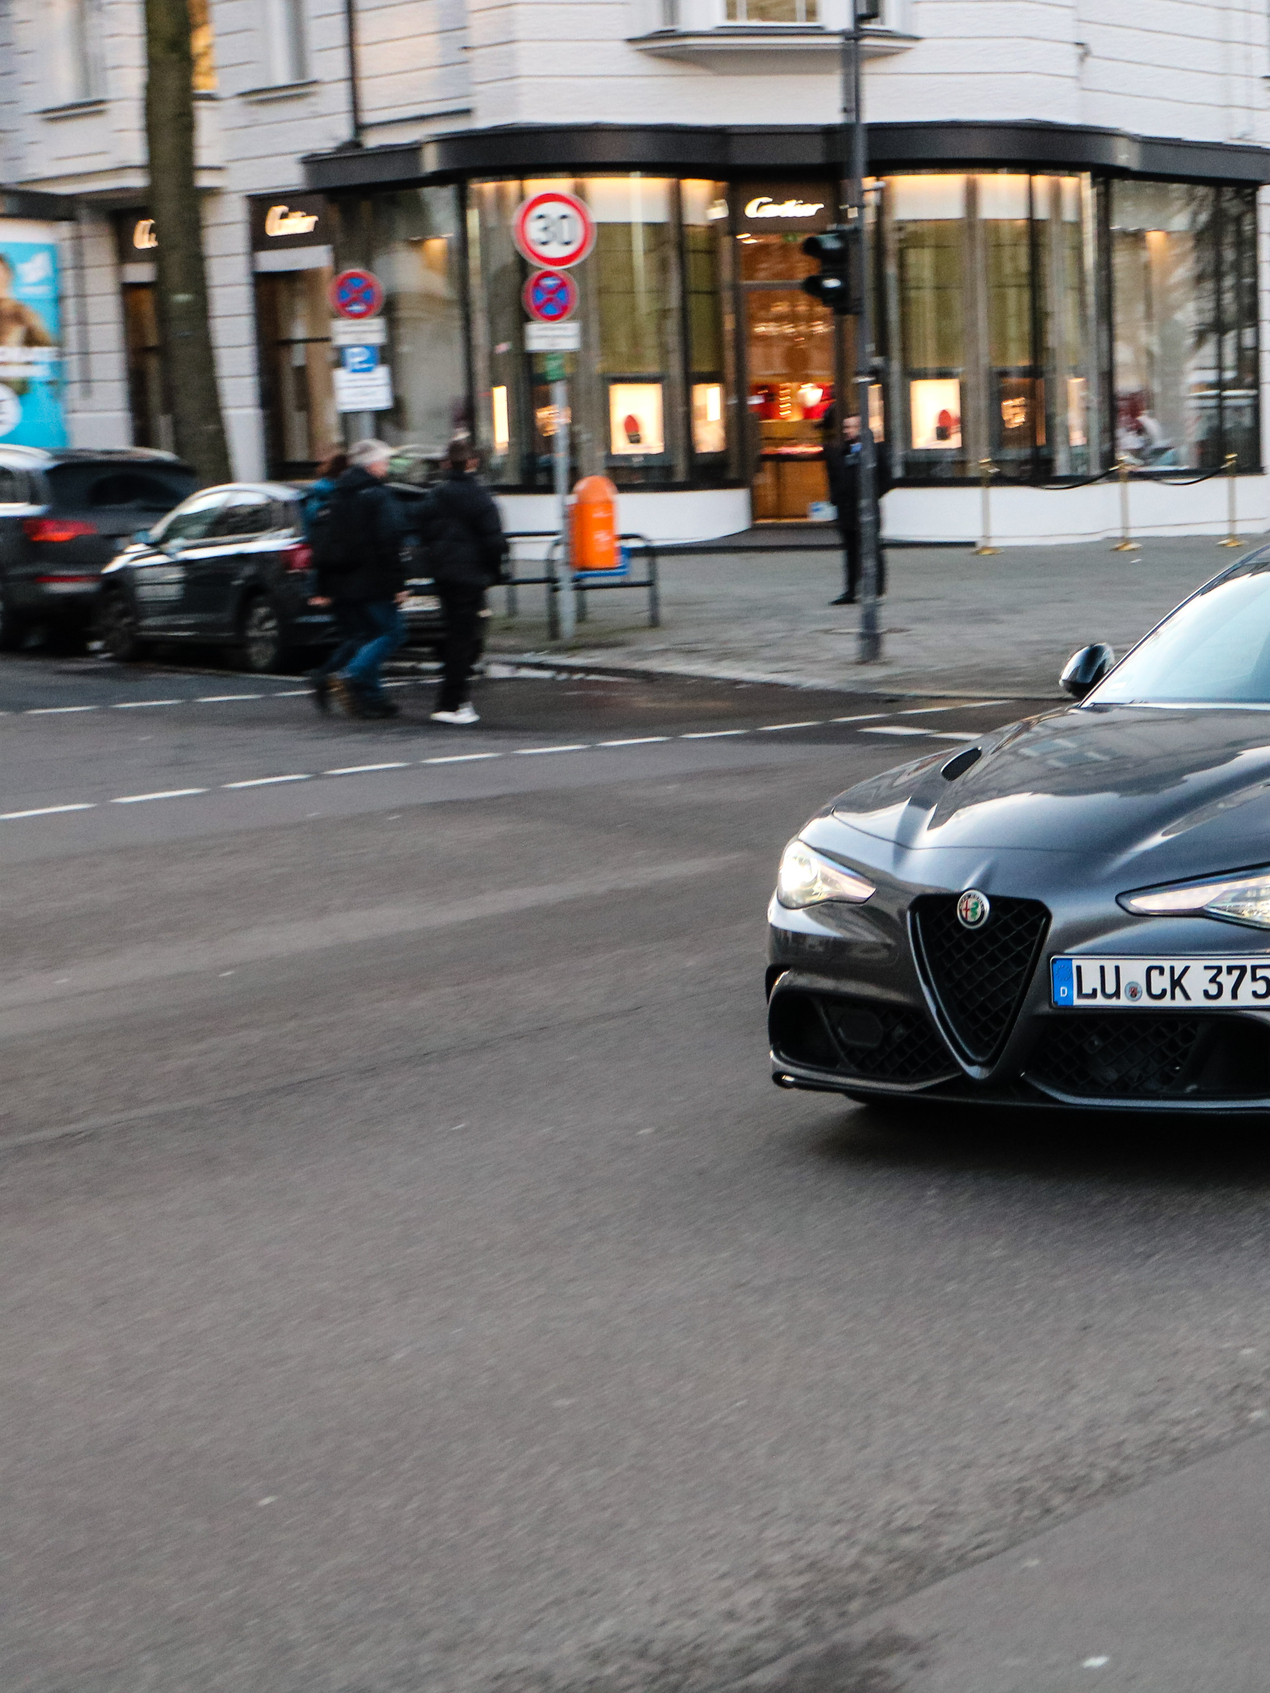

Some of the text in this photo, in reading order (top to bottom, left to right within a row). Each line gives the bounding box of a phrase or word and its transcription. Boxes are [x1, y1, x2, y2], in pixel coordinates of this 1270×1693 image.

[744, 196, 825, 218] Cartier
[532, 213, 579, 246] 30
[1075, 964, 1121, 1001] LU
[1145, 964, 1192, 1001] CK
